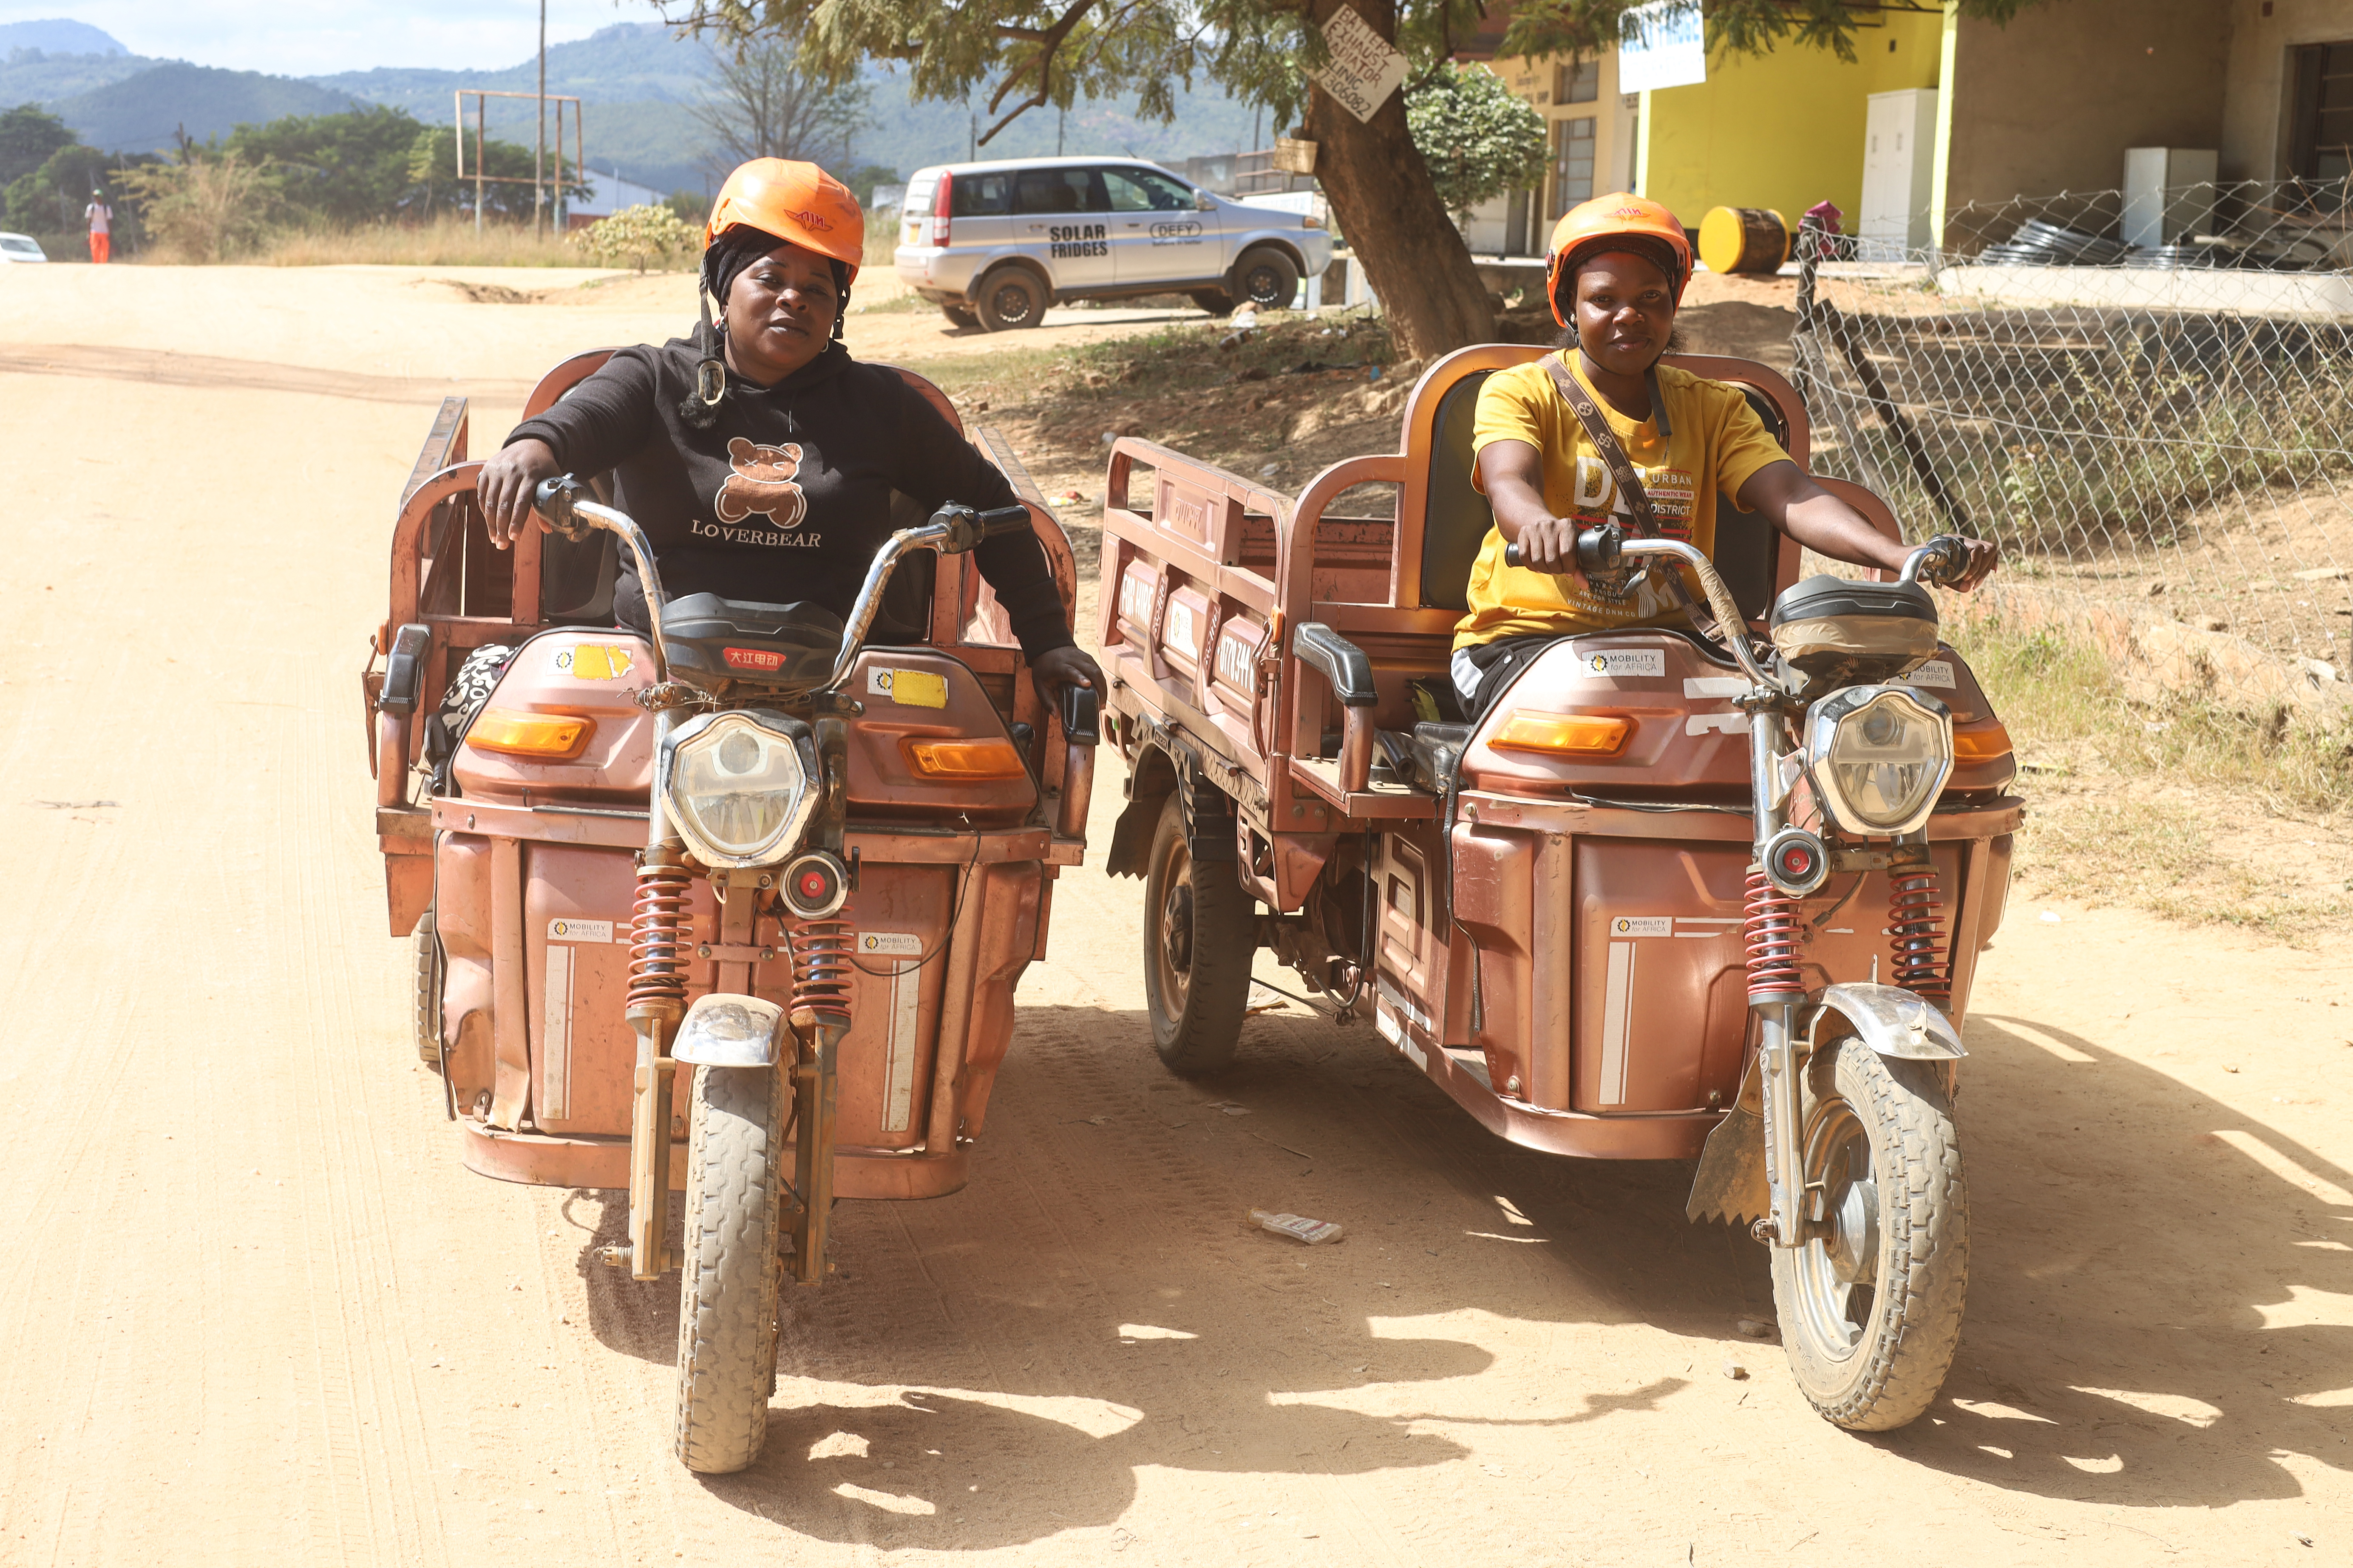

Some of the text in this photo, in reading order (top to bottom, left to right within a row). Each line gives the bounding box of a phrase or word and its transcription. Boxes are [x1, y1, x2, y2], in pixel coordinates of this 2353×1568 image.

[1338, 8, 1397, 57] BATTERY
[1328, 21, 1389, 73] EXHAUST
[1050, 224, 1106, 242] SOLAR
[1158, 224, 1193, 237] DEFY
[1051, 241, 1108, 258] FRIDGES
[1653, 474, 1692, 485] URBAN
[1651, 504, 1691, 515] DISTRICT
[690, 519, 822, 548] LOVERBEAR
[1567, 598, 1602, 614] VINTAGE
[731, 651, 778, 666] 大江电动
[1926, 674, 1950, 683] AFRICA
